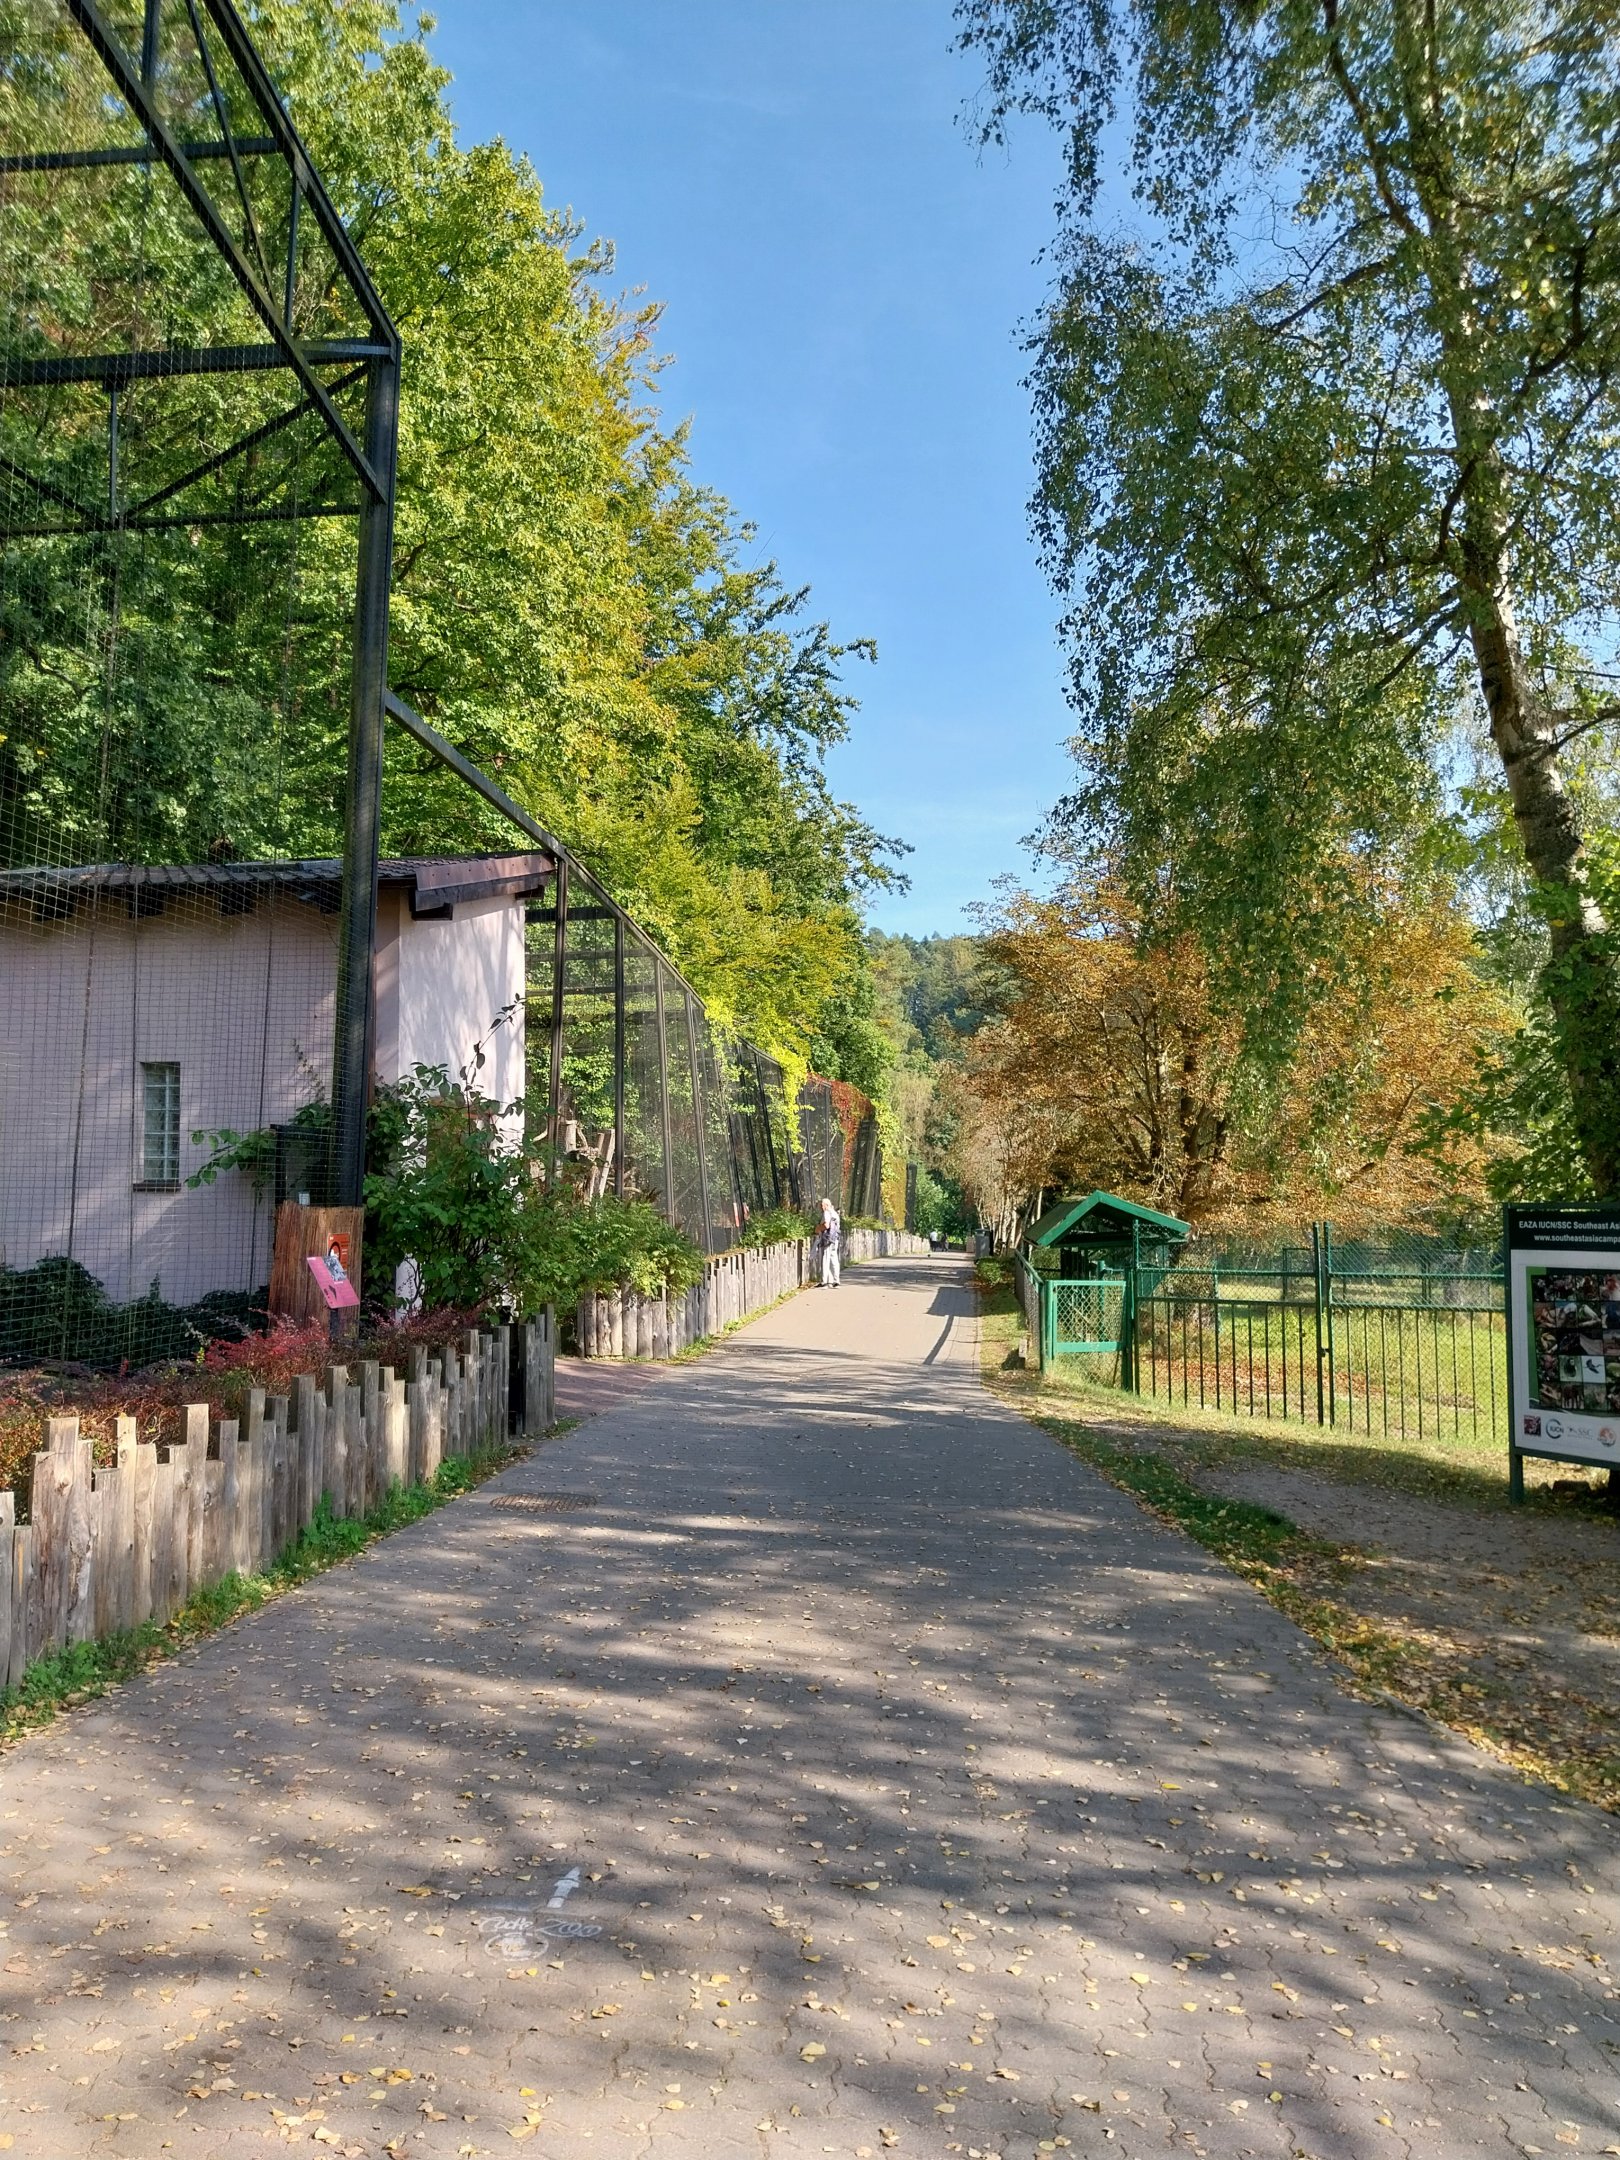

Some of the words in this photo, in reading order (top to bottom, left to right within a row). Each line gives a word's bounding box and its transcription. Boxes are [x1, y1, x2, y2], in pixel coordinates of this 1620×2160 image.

[1519, 1221, 1537, 1229] EAZA
[1538, 1221, 1572, 1229] IUCN/SSC
[1573, 1221, 1609, 1230] Southeast
